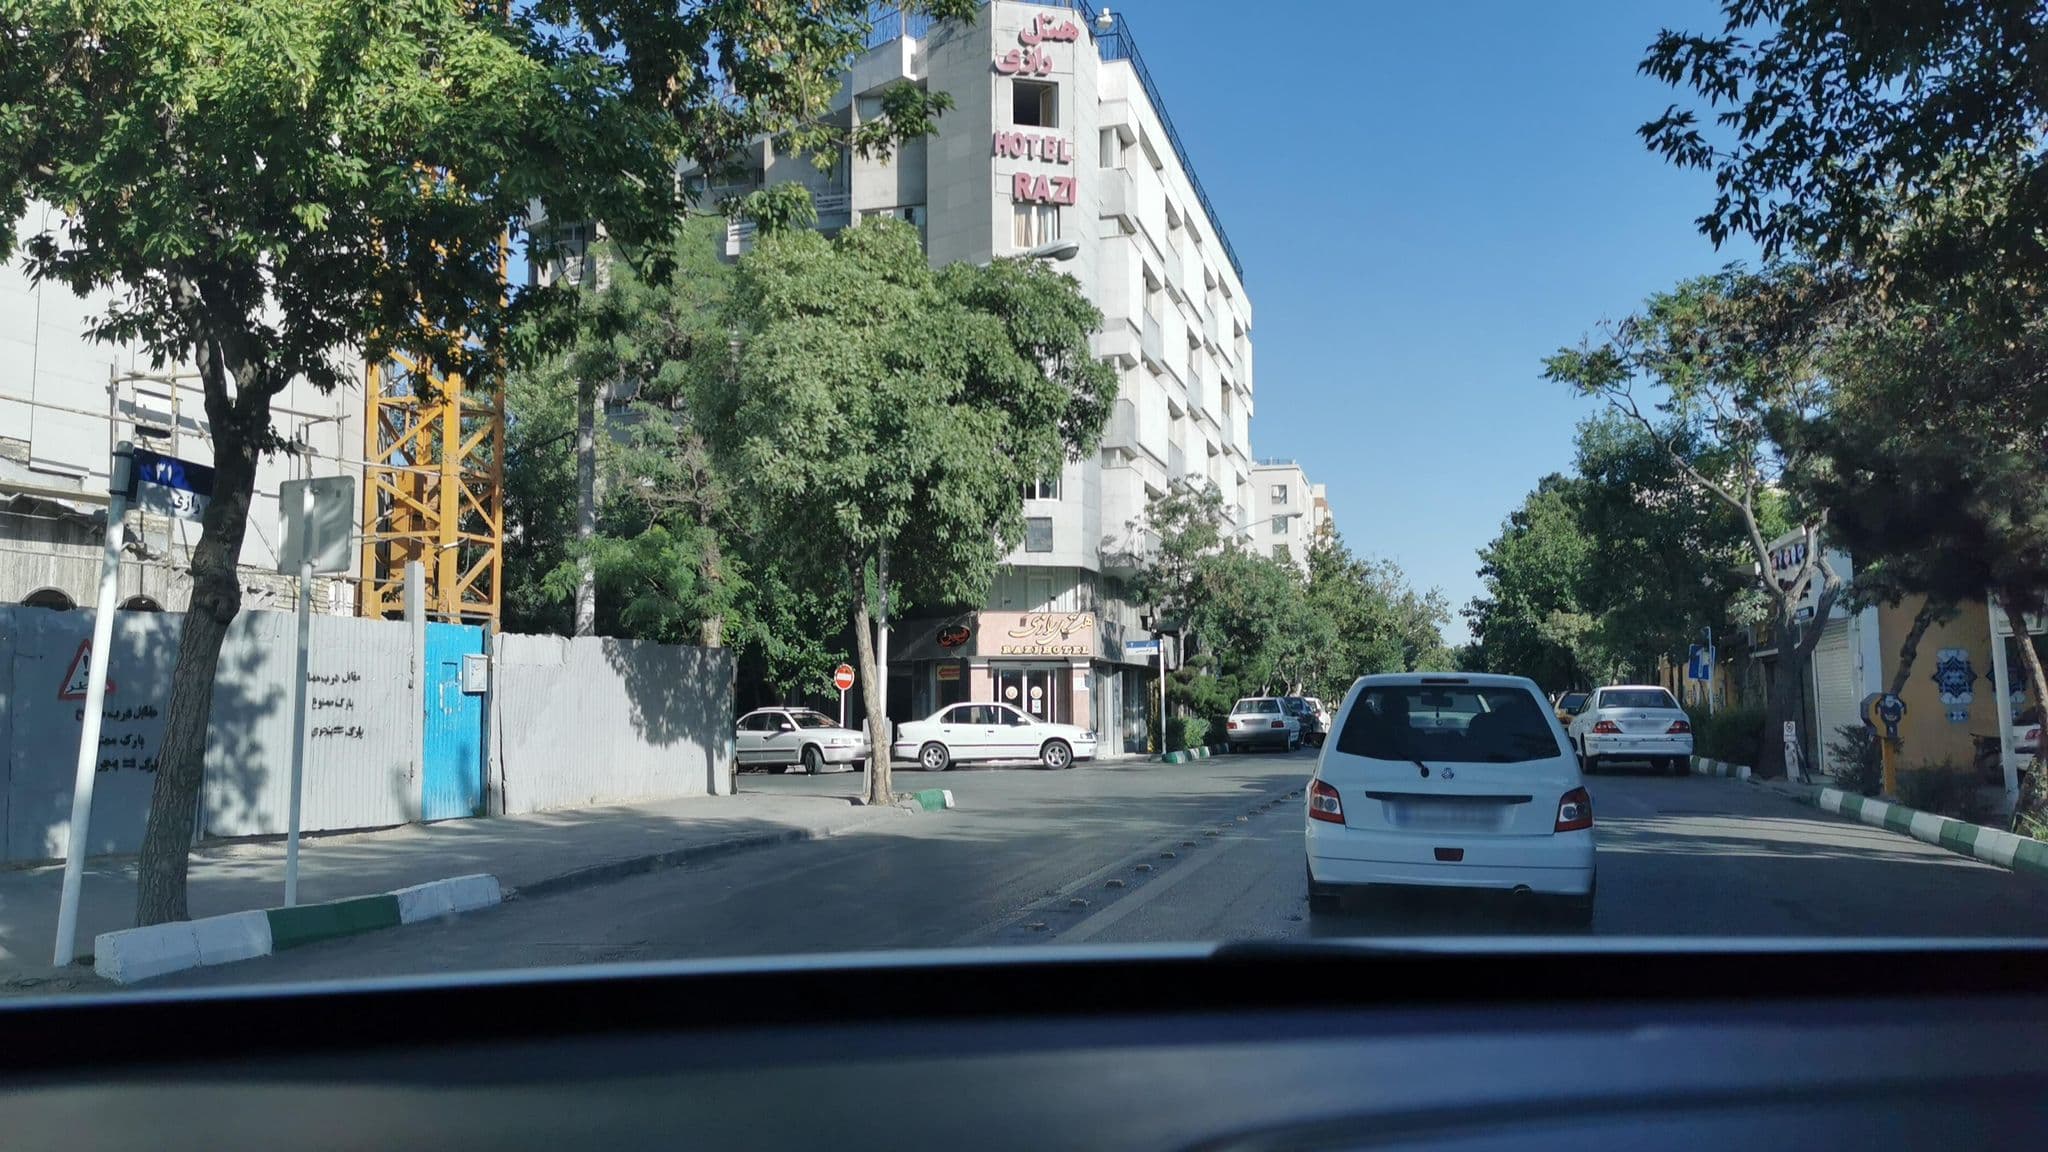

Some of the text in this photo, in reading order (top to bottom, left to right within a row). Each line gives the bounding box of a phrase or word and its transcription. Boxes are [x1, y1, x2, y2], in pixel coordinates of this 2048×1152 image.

[1018, 13, 1079, 47] هتل
[994, 46, 1053, 76] رازی
[994, 131, 1072, 164] HOTEL
[1013, 172, 1077, 206] RAZI
[1001, 645, 1089, 655] RAZI HOTEL
